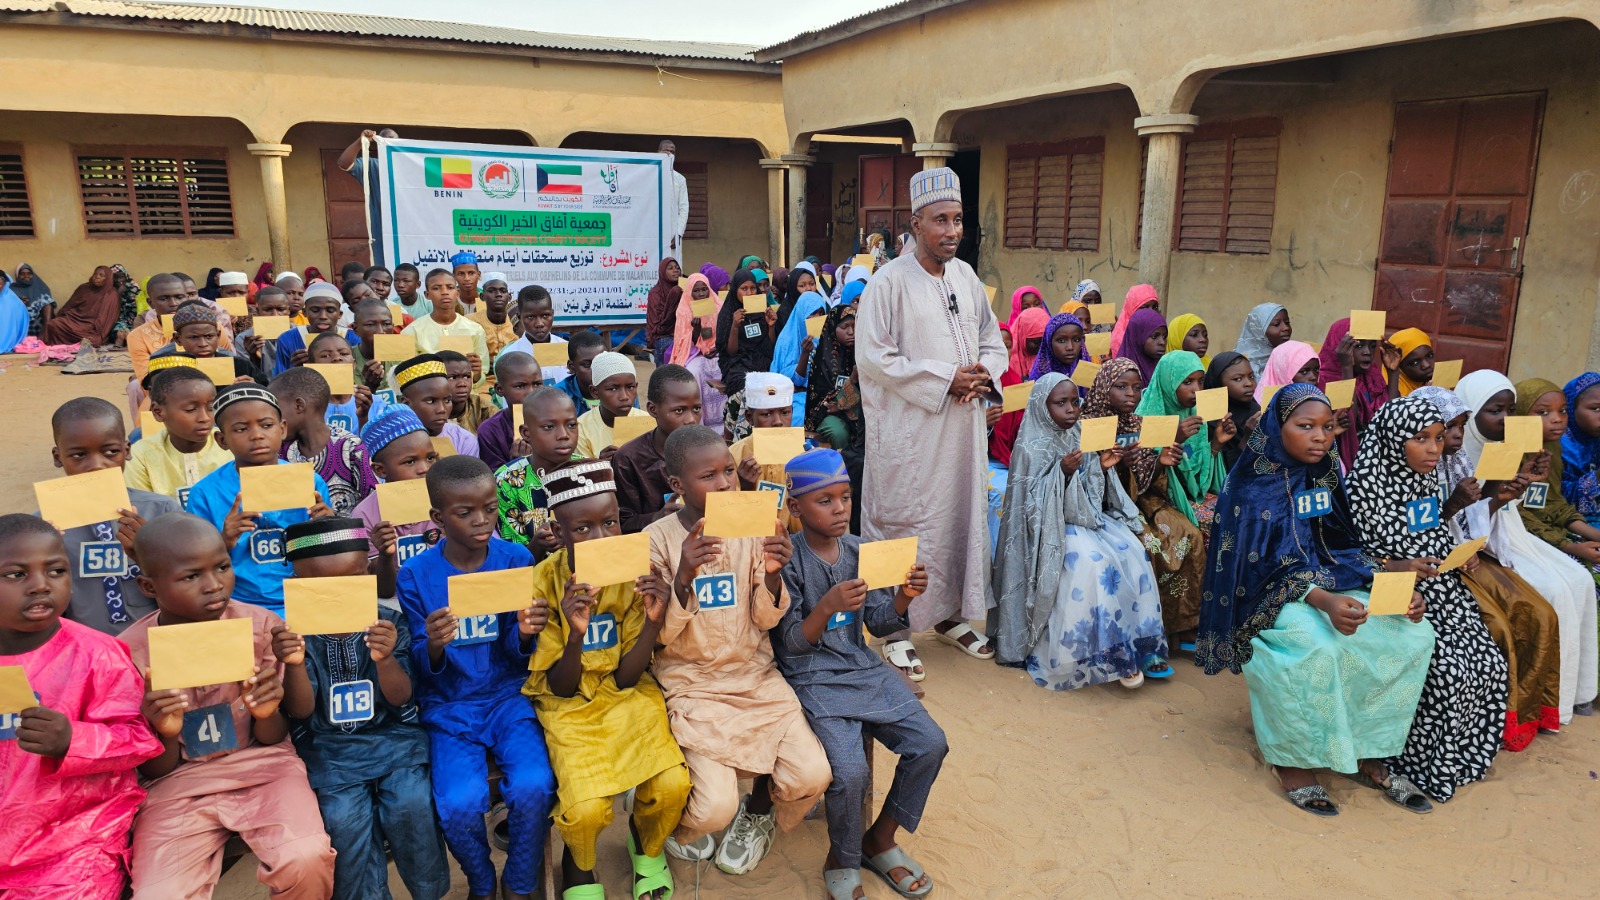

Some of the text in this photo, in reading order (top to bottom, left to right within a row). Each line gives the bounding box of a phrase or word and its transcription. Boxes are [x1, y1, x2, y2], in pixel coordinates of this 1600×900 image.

[434, 190, 463, 198] BENIN
[459, 213, 606, 233] جمعية آفاق الخير الكويتية
[521, 250, 568, 264] مستحقات
[570, 250, 594, 268] توزيع
[634, 251, 649, 267] نوع
[577, 286, 622, 294] 2024/11/01
[563, 299, 579, 313] بنين
[606, 298, 632, 309] منظمة
[1298, 491, 1330, 514] 89
[1528, 486, 1543, 504] 74
[1407, 502, 1434, 526] 12
[257, 538, 281, 556] 66
[398, 543, 427, 561] 112
[87, 547, 121, 571] 58
[698, 579, 733, 605] 43
[333, 689, 371, 715] 113
[197, 713, 222, 744] 4
